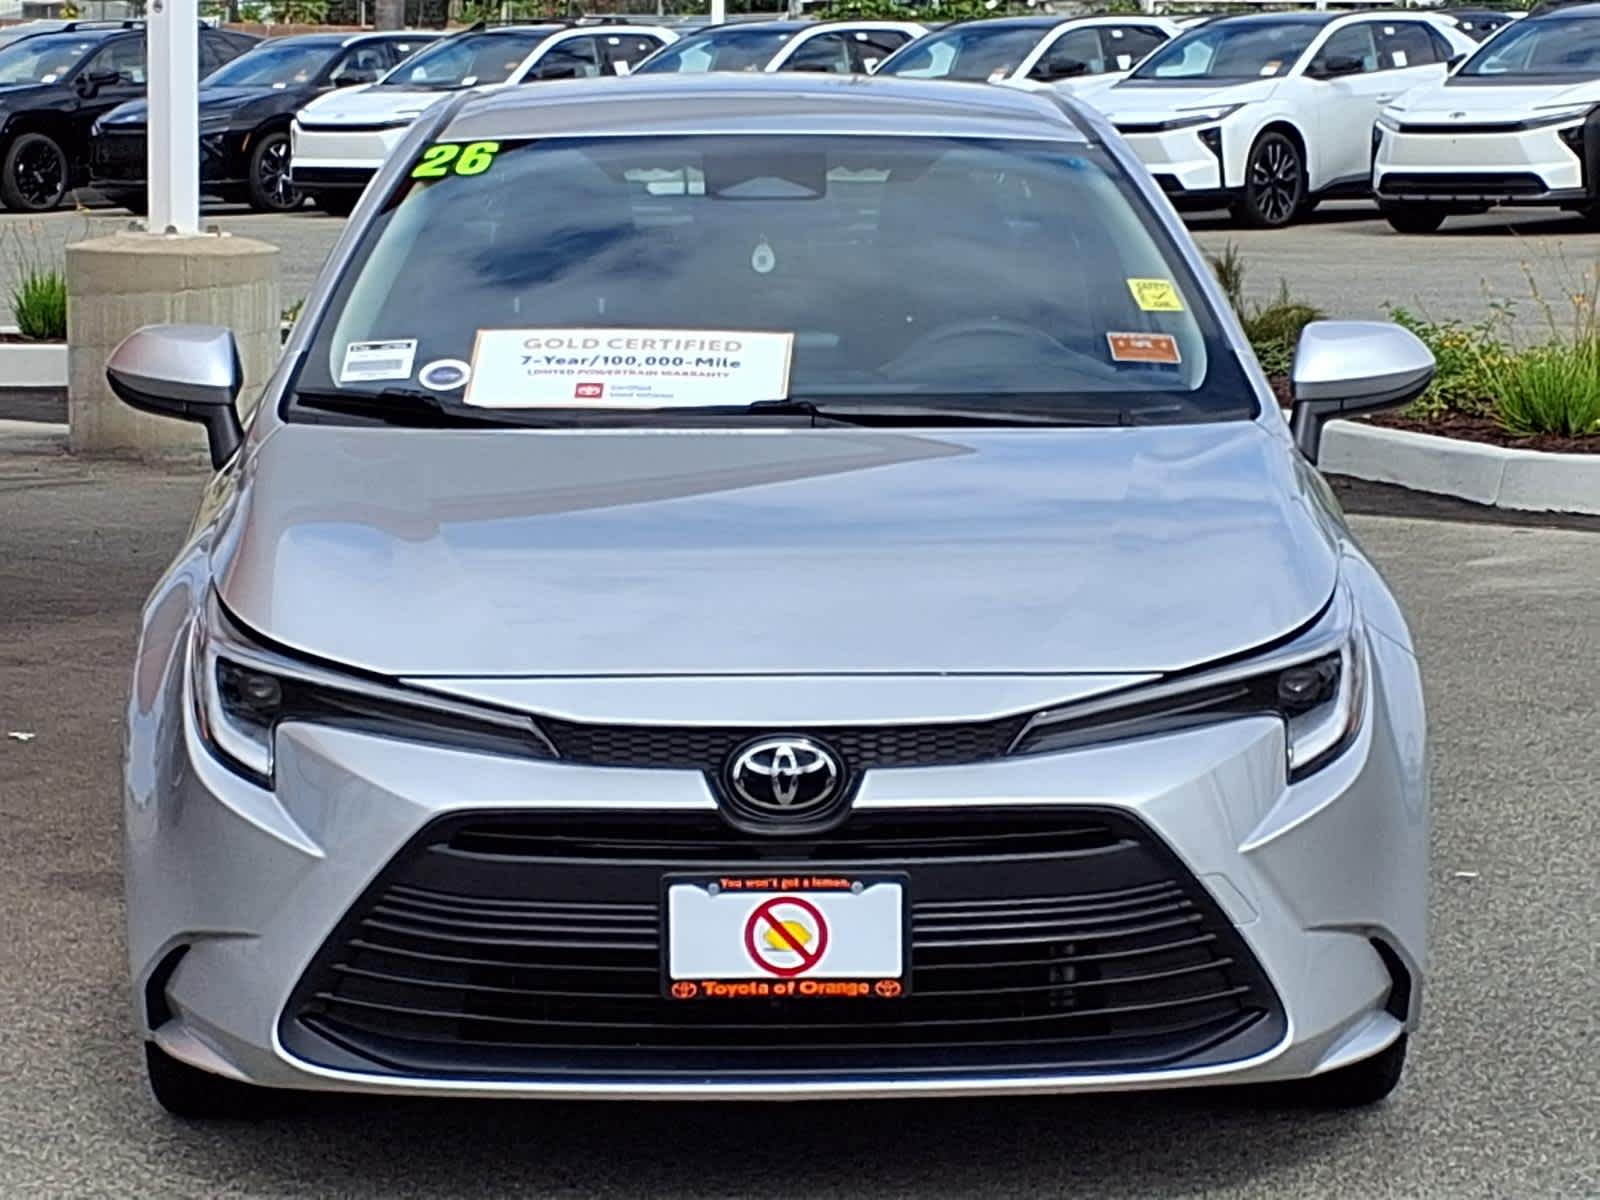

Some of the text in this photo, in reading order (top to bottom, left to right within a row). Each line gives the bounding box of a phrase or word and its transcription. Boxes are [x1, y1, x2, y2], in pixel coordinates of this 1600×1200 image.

[411, 141, 499, 178] 26
[523, 338, 742, 352] GOLD CERTIFIED
[521, 354, 741, 368] 7-Year/100,000-Mile
[702, 981, 869, 997] Toyota of Orange
